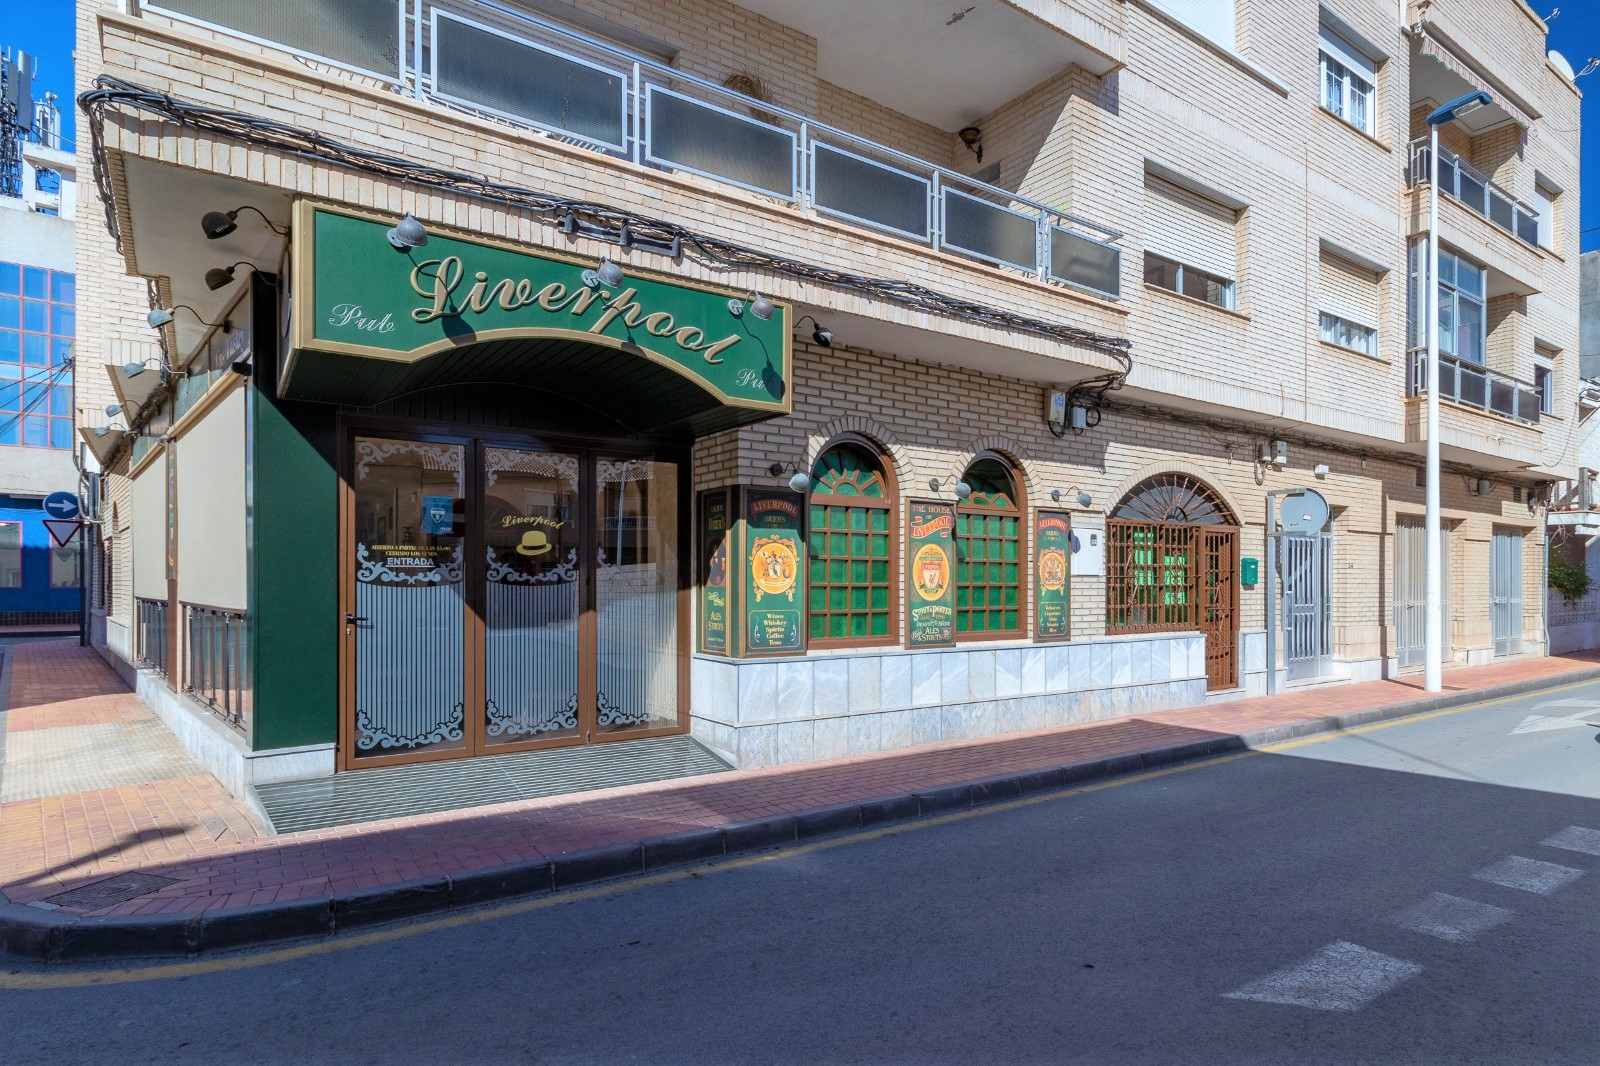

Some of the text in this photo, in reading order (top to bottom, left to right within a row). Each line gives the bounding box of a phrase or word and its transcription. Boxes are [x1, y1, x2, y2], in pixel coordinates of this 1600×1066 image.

[410, 256, 741, 364] Liverpool
[328, 303, 396, 333] Pub
[735, 367, 769, 391] Pu
[754, 500, 798, 515] LIVERPOOL
[912, 505, 951, 514] THE HOUSE
[502, 515, 564, 529] Liverpool
[912, 517, 950, 537] LIVERPOOL
[387, 557, 435, 566] ENTRADA
[763, 619, 787, 627] Whiskey
[765, 626, 785, 634] Spirits
[925, 627, 940, 635] ALES
[921, 633, 943, 642] STOUTS
